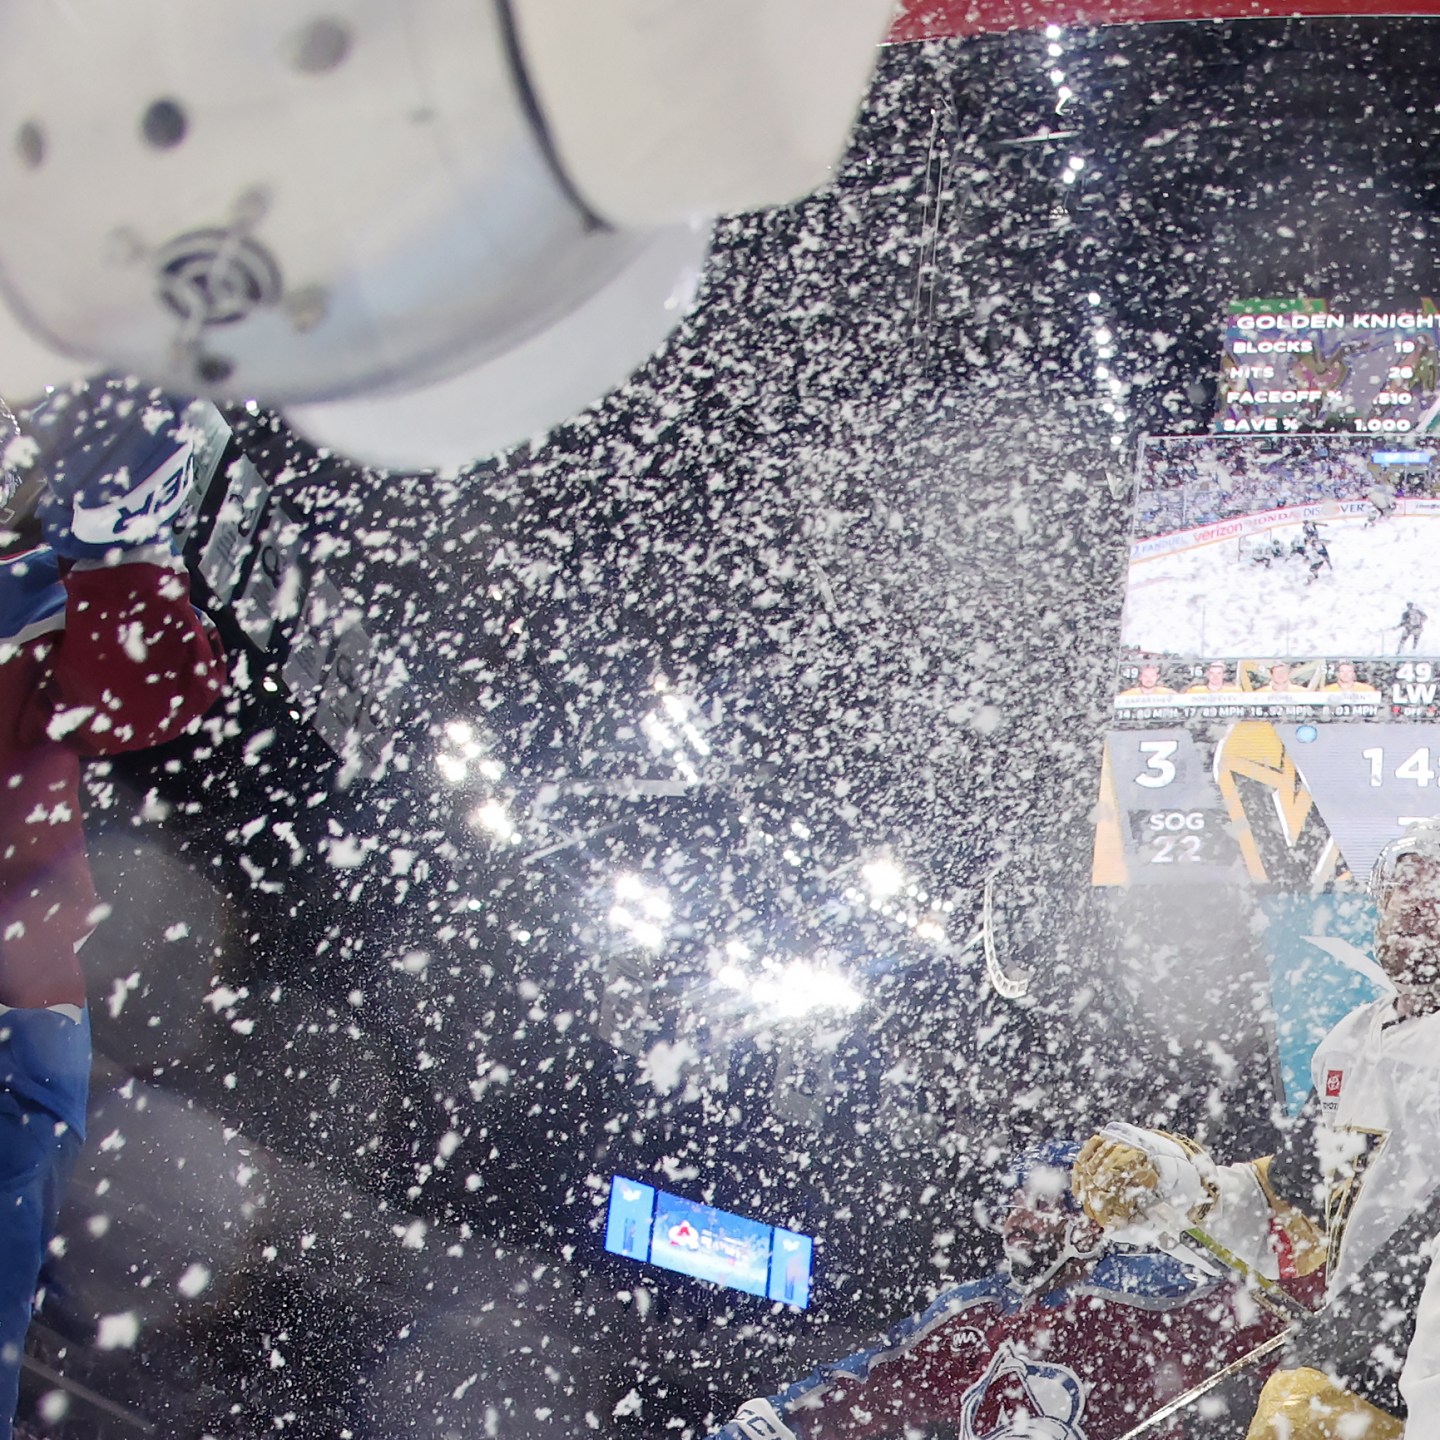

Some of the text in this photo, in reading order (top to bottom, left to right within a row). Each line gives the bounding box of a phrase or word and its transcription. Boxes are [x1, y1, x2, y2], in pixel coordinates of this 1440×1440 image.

[1236, 314, 1345, 329] GOLDEN
[1232, 340, 1415, 353] BLOCKS 19
[1229, 366, 1414, 379] HITS 26
[1226, 391, 1322, 404] FACEOFF
[1222, 418, 1411, 431] SAVE % 1.000
[1192, 522, 1243, 542] verizon
[1302, 503, 1365, 517] DISVER
[1395, 662, 1433, 683] 49
[1391, 683, 1437, 704] LW
[1152, 708, 1179, 719] MPH
[1219, 706, 1245, 717] MPH
[1352, 705, 1378, 716] MPH
[1133, 740, 1179, 788] 3
[1149, 812, 1205, 831] SOG
[1150, 835, 1202, 863] 22
